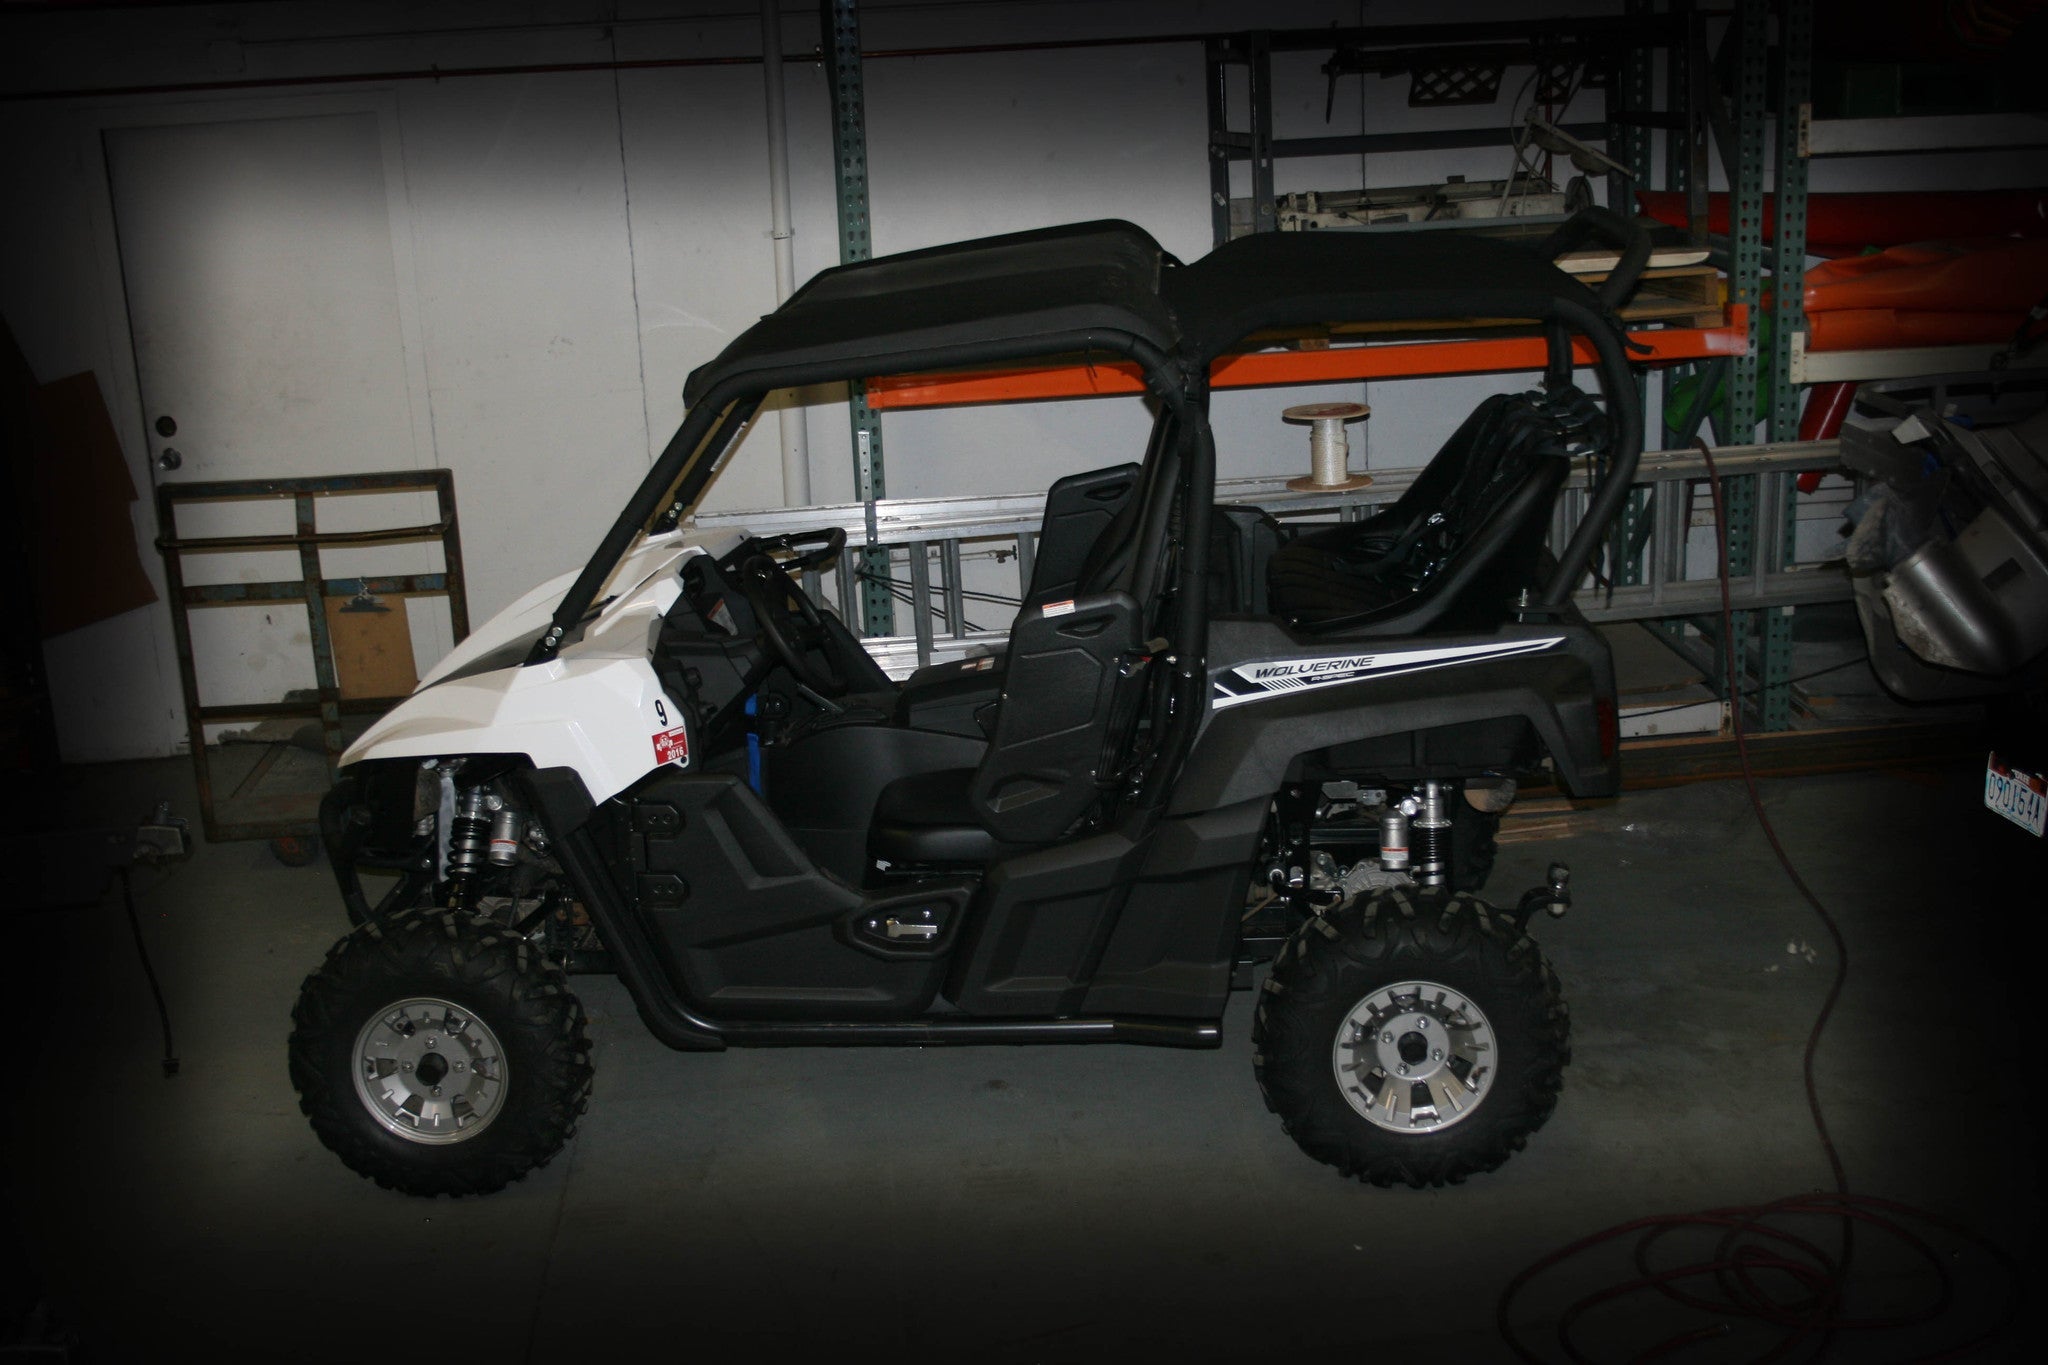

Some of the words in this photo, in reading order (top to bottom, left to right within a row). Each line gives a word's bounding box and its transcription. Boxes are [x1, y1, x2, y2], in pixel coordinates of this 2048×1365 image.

[1255, 656, 1375, 679] WOLVERINE
[655, 699, 668, 727] 9
[667, 746, 685, 760] 2016
